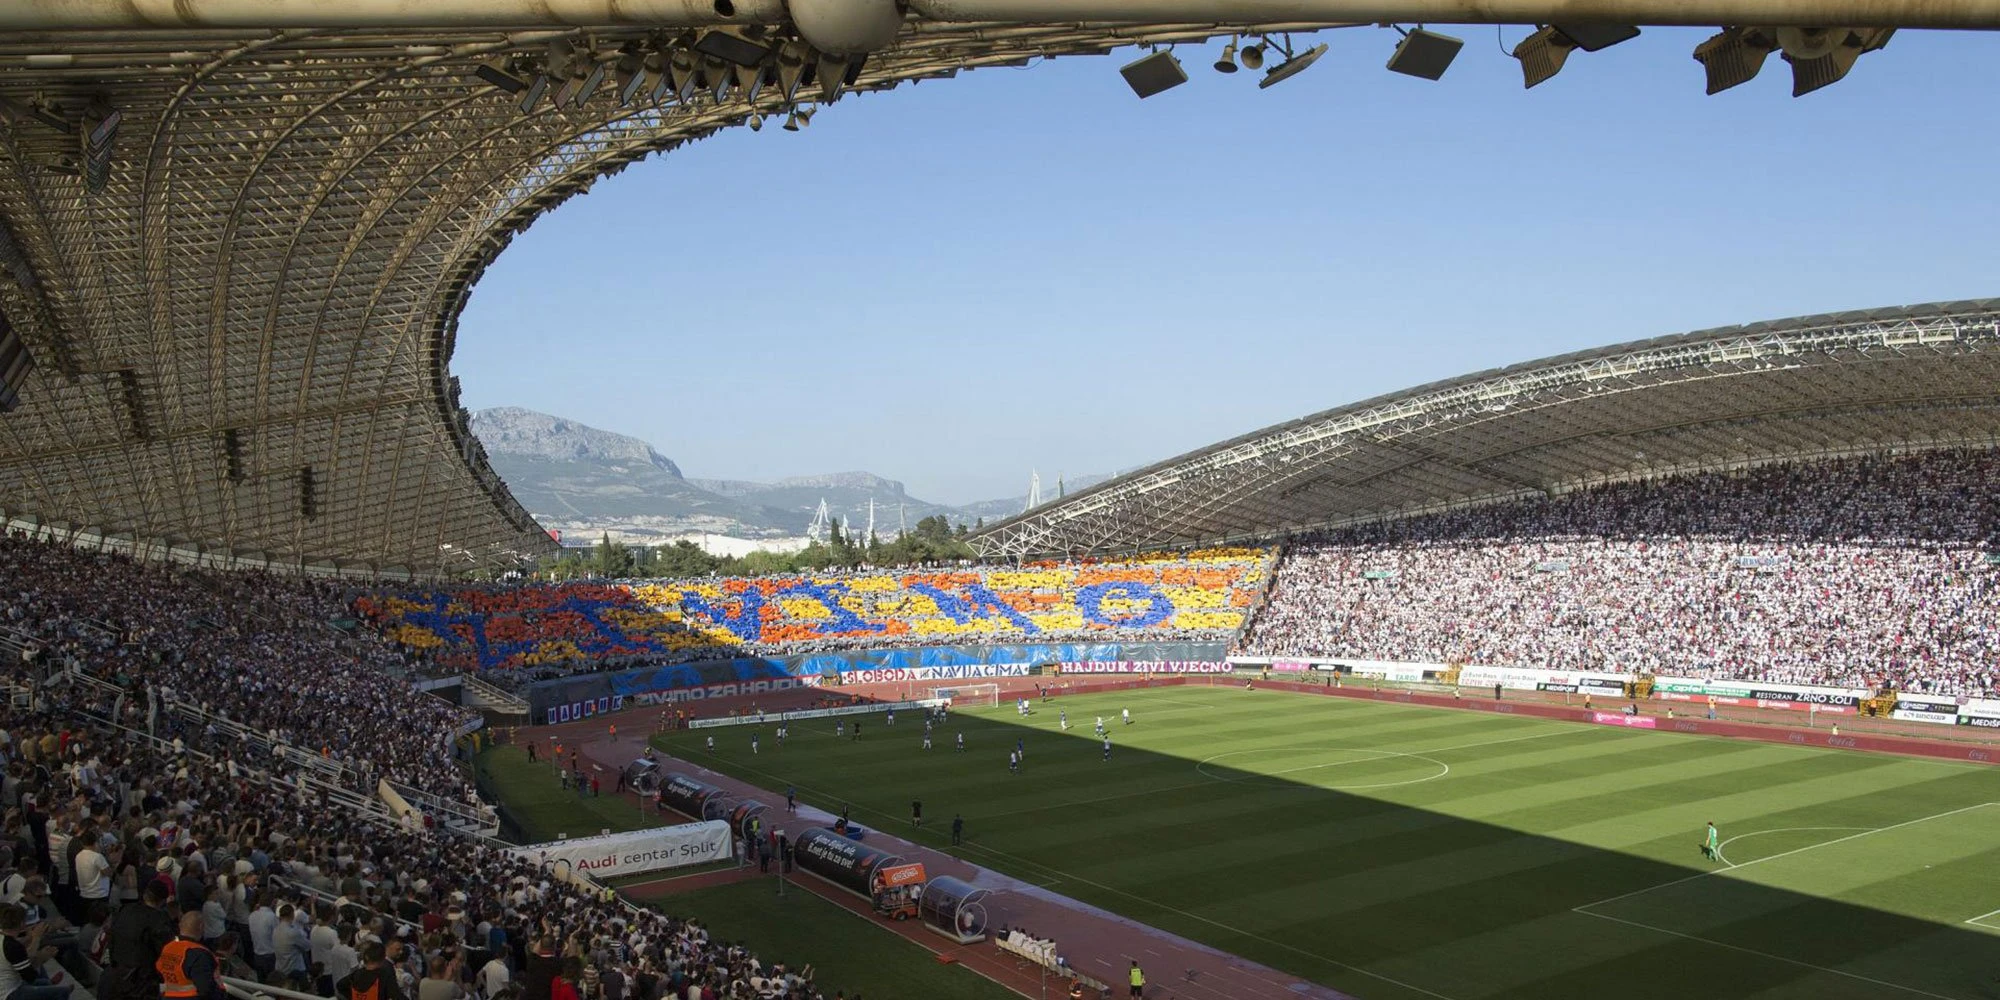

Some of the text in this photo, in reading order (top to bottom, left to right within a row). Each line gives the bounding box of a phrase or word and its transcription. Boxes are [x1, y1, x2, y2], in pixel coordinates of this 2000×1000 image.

[1062, 661, 1129, 673] HAJDUK
[847, 669, 917, 684] SLOBODA
[708, 684, 738, 699] ZA
[1756, 692, 1793, 700] RESTORAN
[1796, 693, 1853, 705] ZRNO SOLI
[577, 841, 716, 871] Audi centar Split
